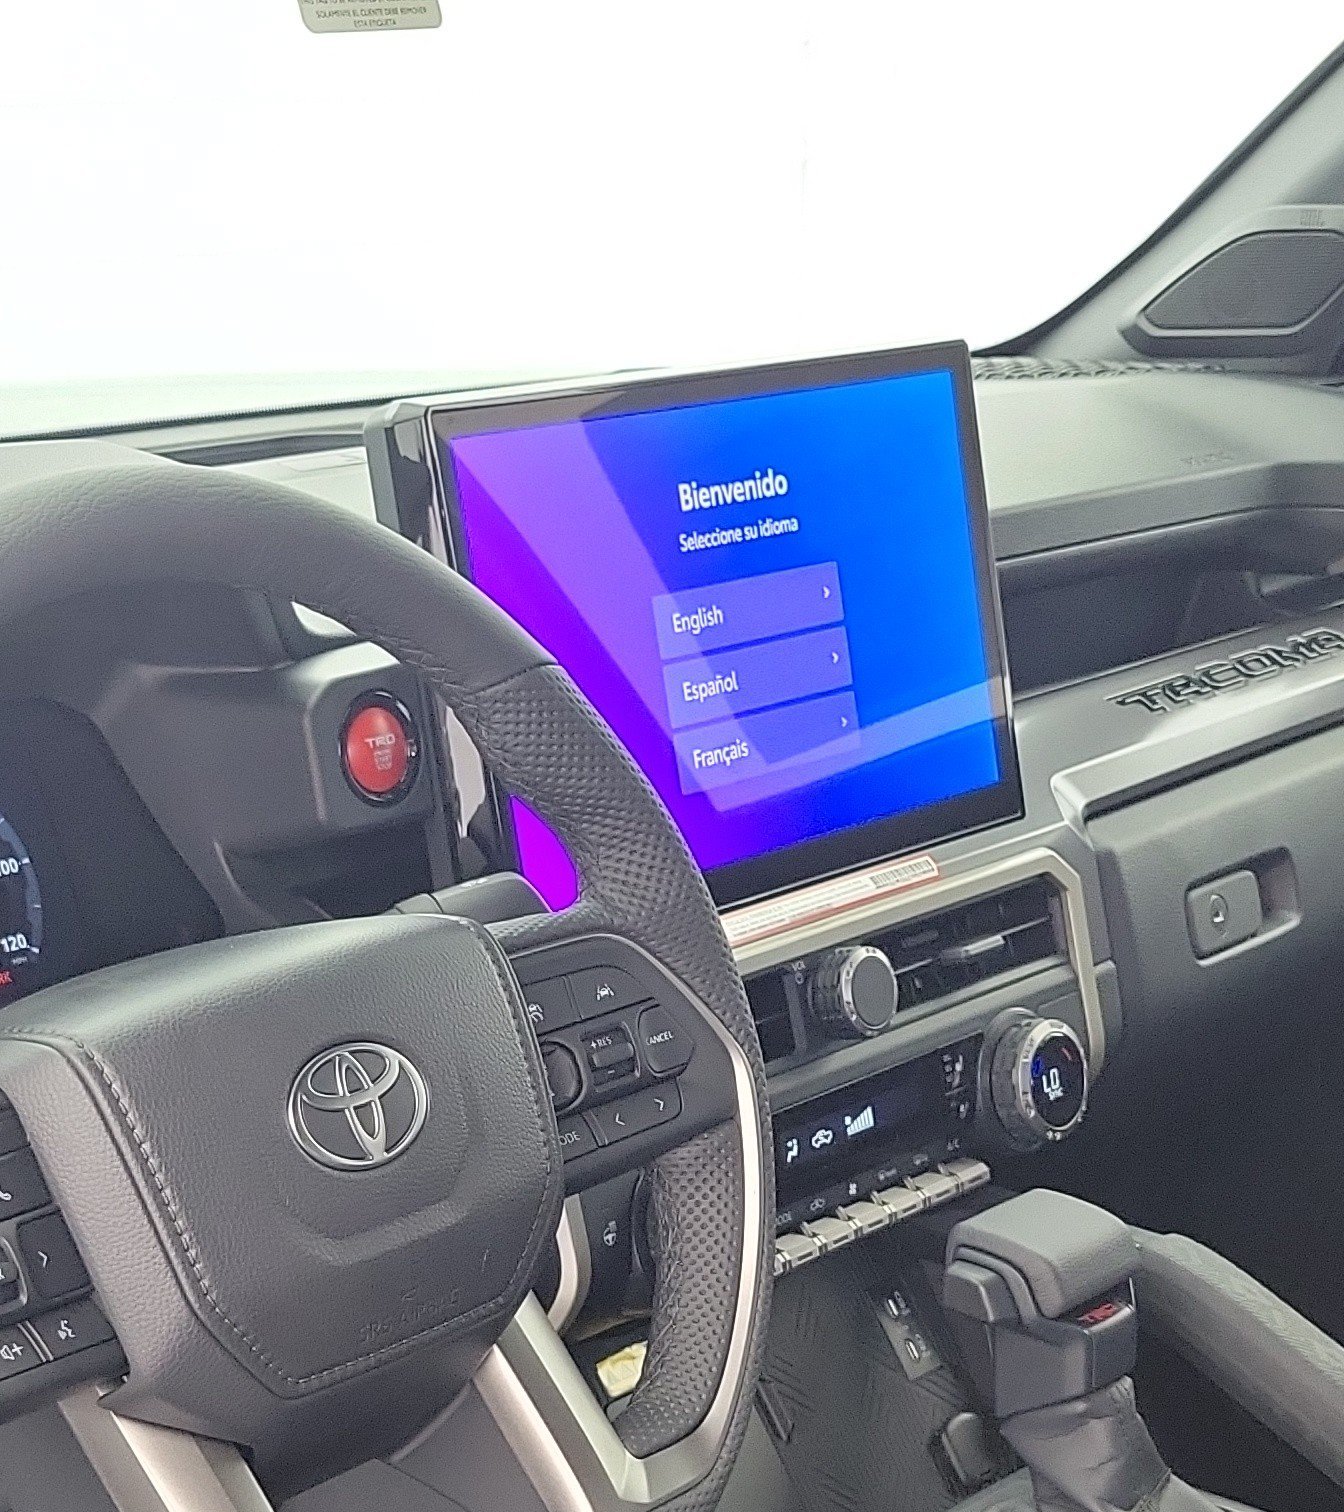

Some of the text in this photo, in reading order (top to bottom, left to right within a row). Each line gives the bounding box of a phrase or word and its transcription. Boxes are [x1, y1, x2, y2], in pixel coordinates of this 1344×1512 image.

[678, 467, 789, 512] Bienvenido
[679, 517, 800, 552] Seleccione su idioma
[672, 604, 724, 635] English
[682, 670, 739, 702] Español
[692, 738, 750, 769] Français
[0, 932, 28, 953] 120
[1042, 1067, 1060, 1093] LO
[558, 1130, 581, 1146] ODE
